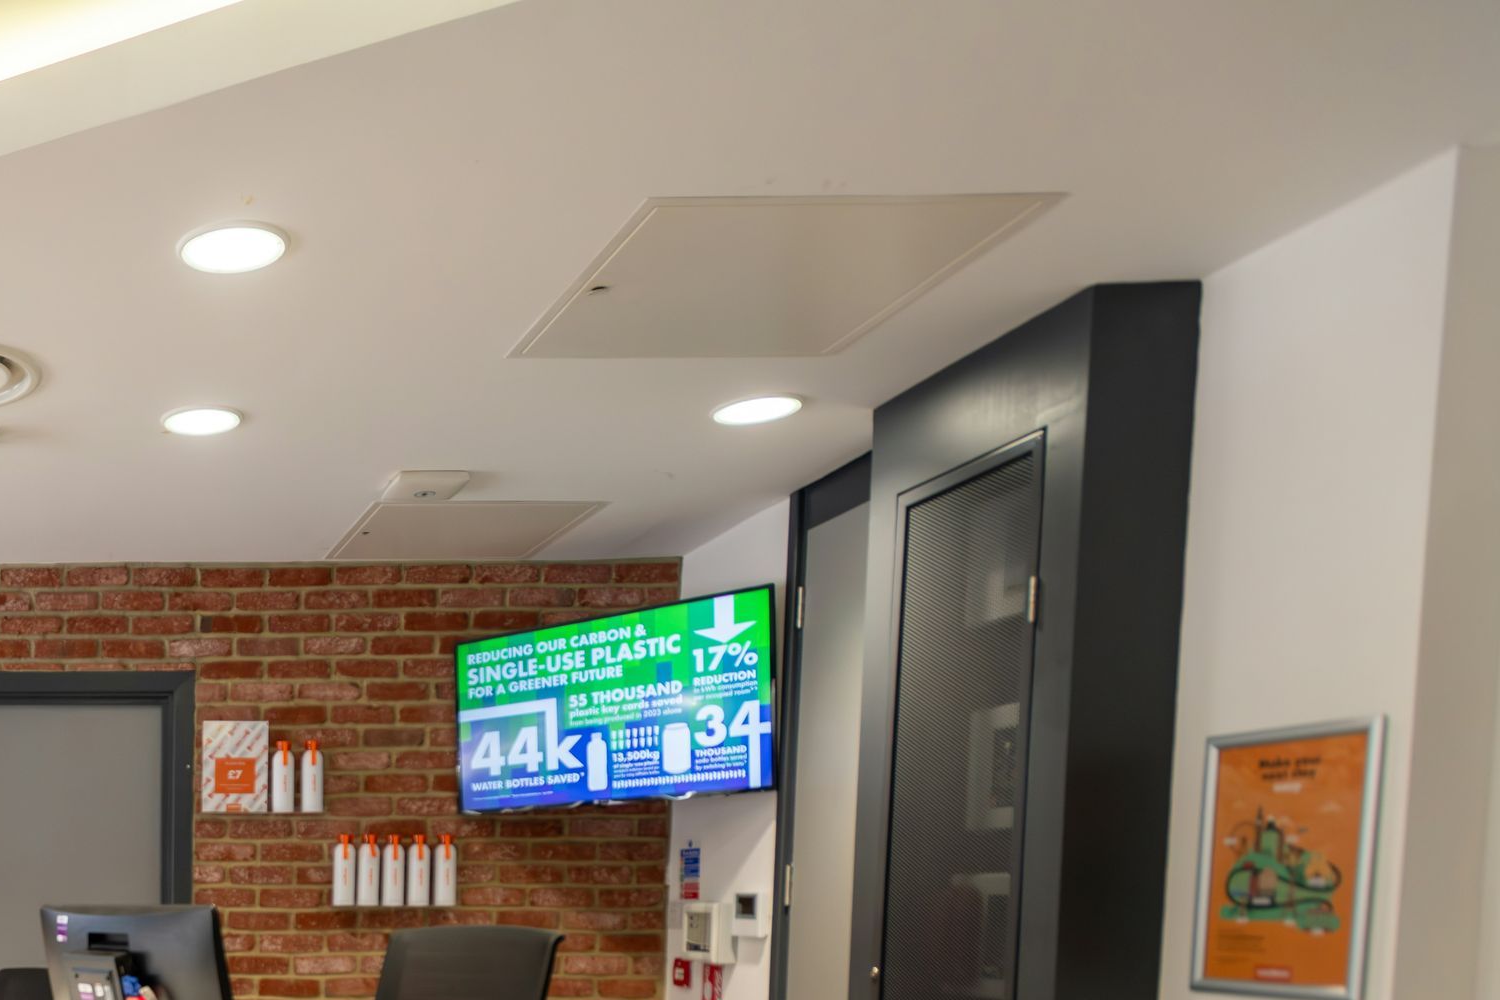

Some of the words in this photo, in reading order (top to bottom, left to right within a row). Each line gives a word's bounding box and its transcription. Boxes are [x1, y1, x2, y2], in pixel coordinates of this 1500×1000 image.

[467, 644, 534, 665] REDUCING
[537, 638, 567, 654] OUR
[570, 626, 631, 649] CARBON
[634, 624, 647, 637] &
[467, 650, 585, 686] SINGLE-USE
[591, 634, 681, 666] PLASTIC
[692, 640, 758, 673] 17%
[467, 686, 493, 700] FOR
[495, 684, 506, 695] A
[508, 674, 568, 693] GREENER
[571, 665, 623, 683] FUTURE
[569, 693, 587, 708] 55
[591, 680, 683, 705] THOUSAND
[693, 669, 756, 687] REDUCTION
[569, 706, 599, 719] plastic
[601, 704, 620, 714] key
[622, 700, 650, 711] cards
[651, 694, 683, 707] saved
[471, 704, 584, 776] 44k
[694, 700, 771, 775] 34
[695, 745, 747, 757] THOUSAND
[471, 781, 504, 792] WATER
[505, 776, 545, 789] BOTTLES
